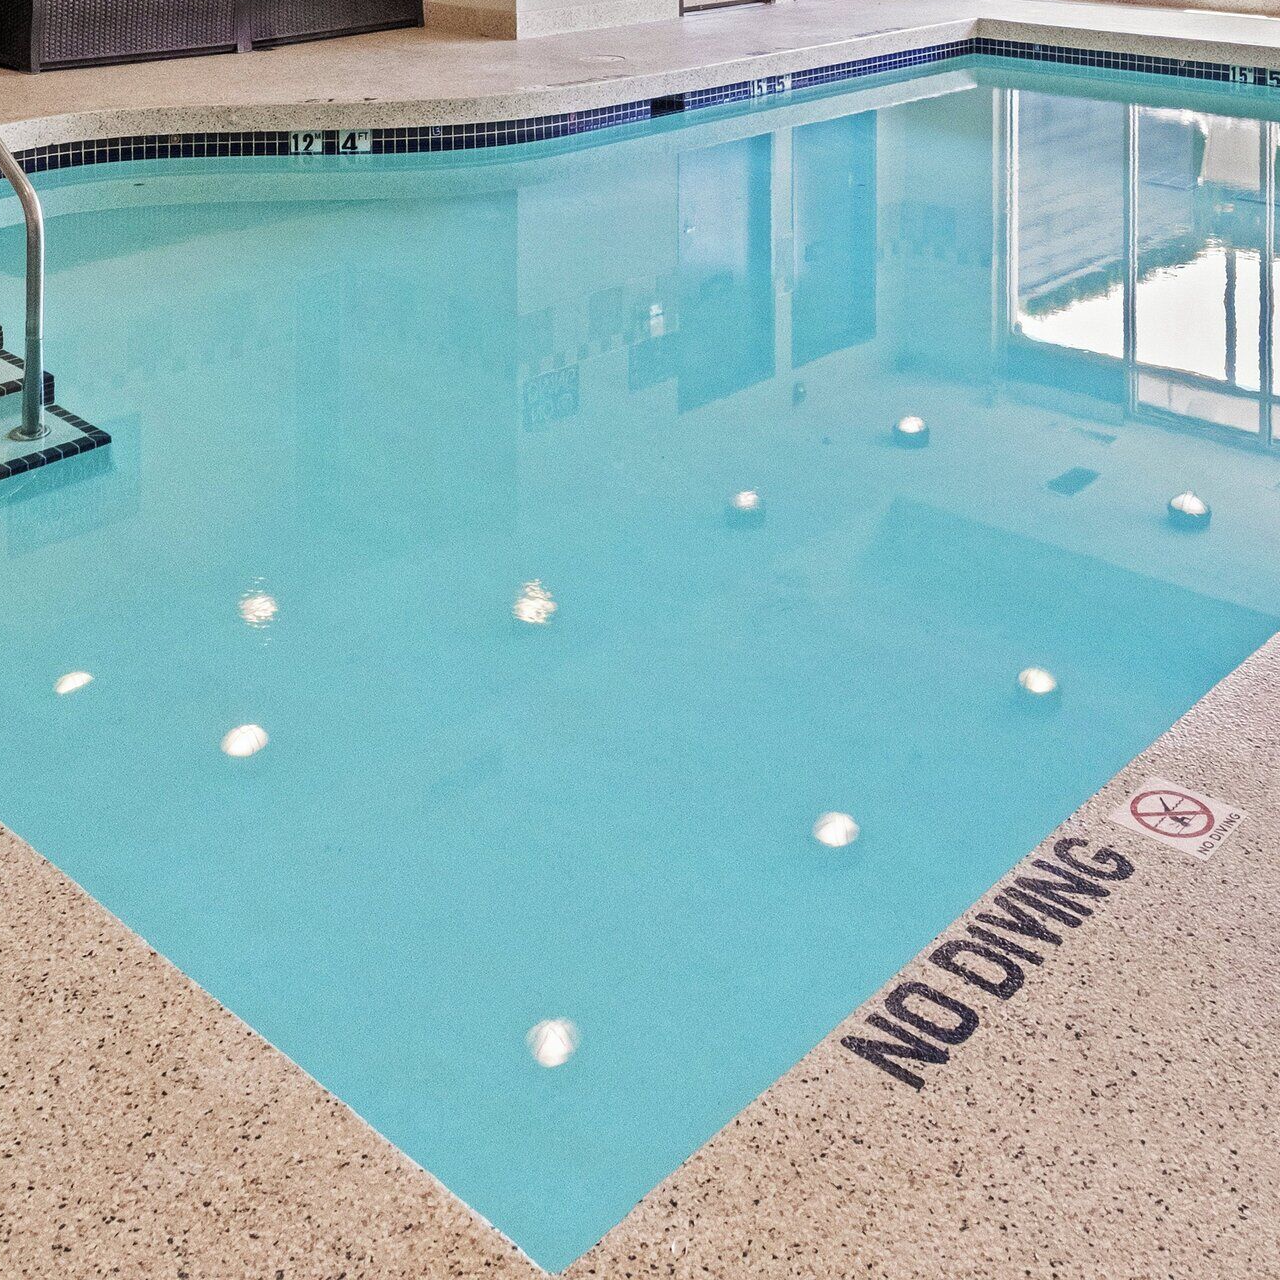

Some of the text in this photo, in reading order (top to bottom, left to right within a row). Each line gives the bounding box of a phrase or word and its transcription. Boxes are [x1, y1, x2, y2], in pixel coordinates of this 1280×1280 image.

[1196, 812, 1241, 856] NO DIVING
[840, 837, 1136, 1093] NO DIVING
